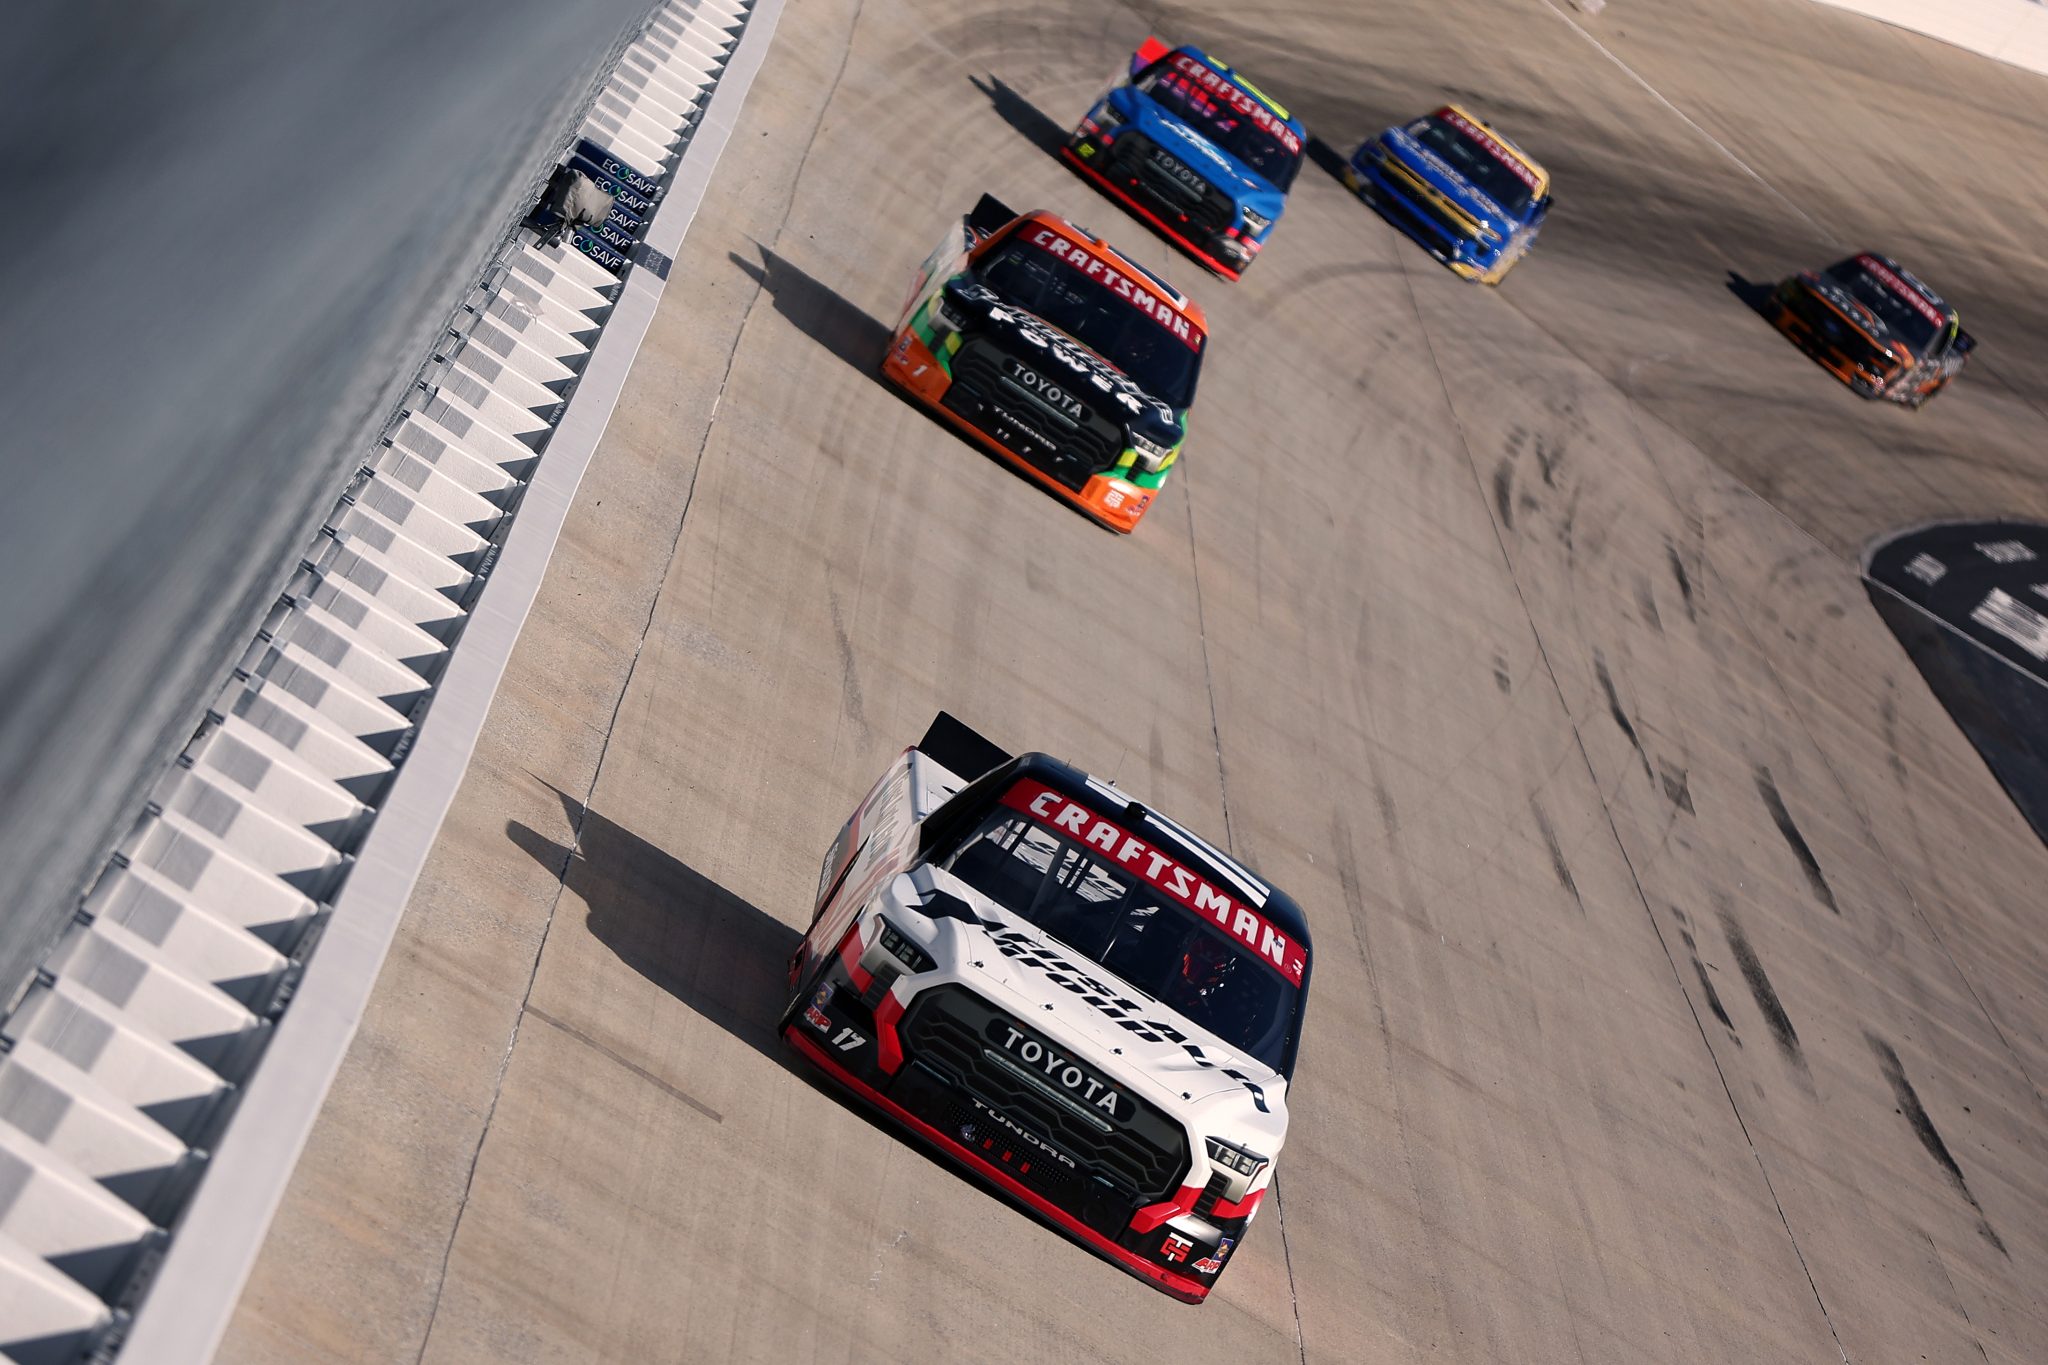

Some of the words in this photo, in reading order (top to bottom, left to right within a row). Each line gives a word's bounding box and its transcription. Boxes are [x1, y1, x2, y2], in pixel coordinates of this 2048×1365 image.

[602, 158, 656, 196] ECOSAVE
[1154, 148, 1207, 193] TOYOTA
[594, 176, 649, 214] ECOSAVE
[608, 209, 639, 231] SAVE
[571, 235, 622, 269] COSAVE
[1034, 230, 1191, 342] CRAFTSMAN
[911, 364, 928, 378] 1
[988, 306, 1143, 415] POWER
[1011, 361, 1085, 420] TOYOTA
[1027, 792, 1289, 967] CRAFTSMAN
[830, 1025, 868, 1053] 17
[1004, 1026, 1120, 1116] TOYOTA
[969, 1098, 1077, 1169] TUNDRA
